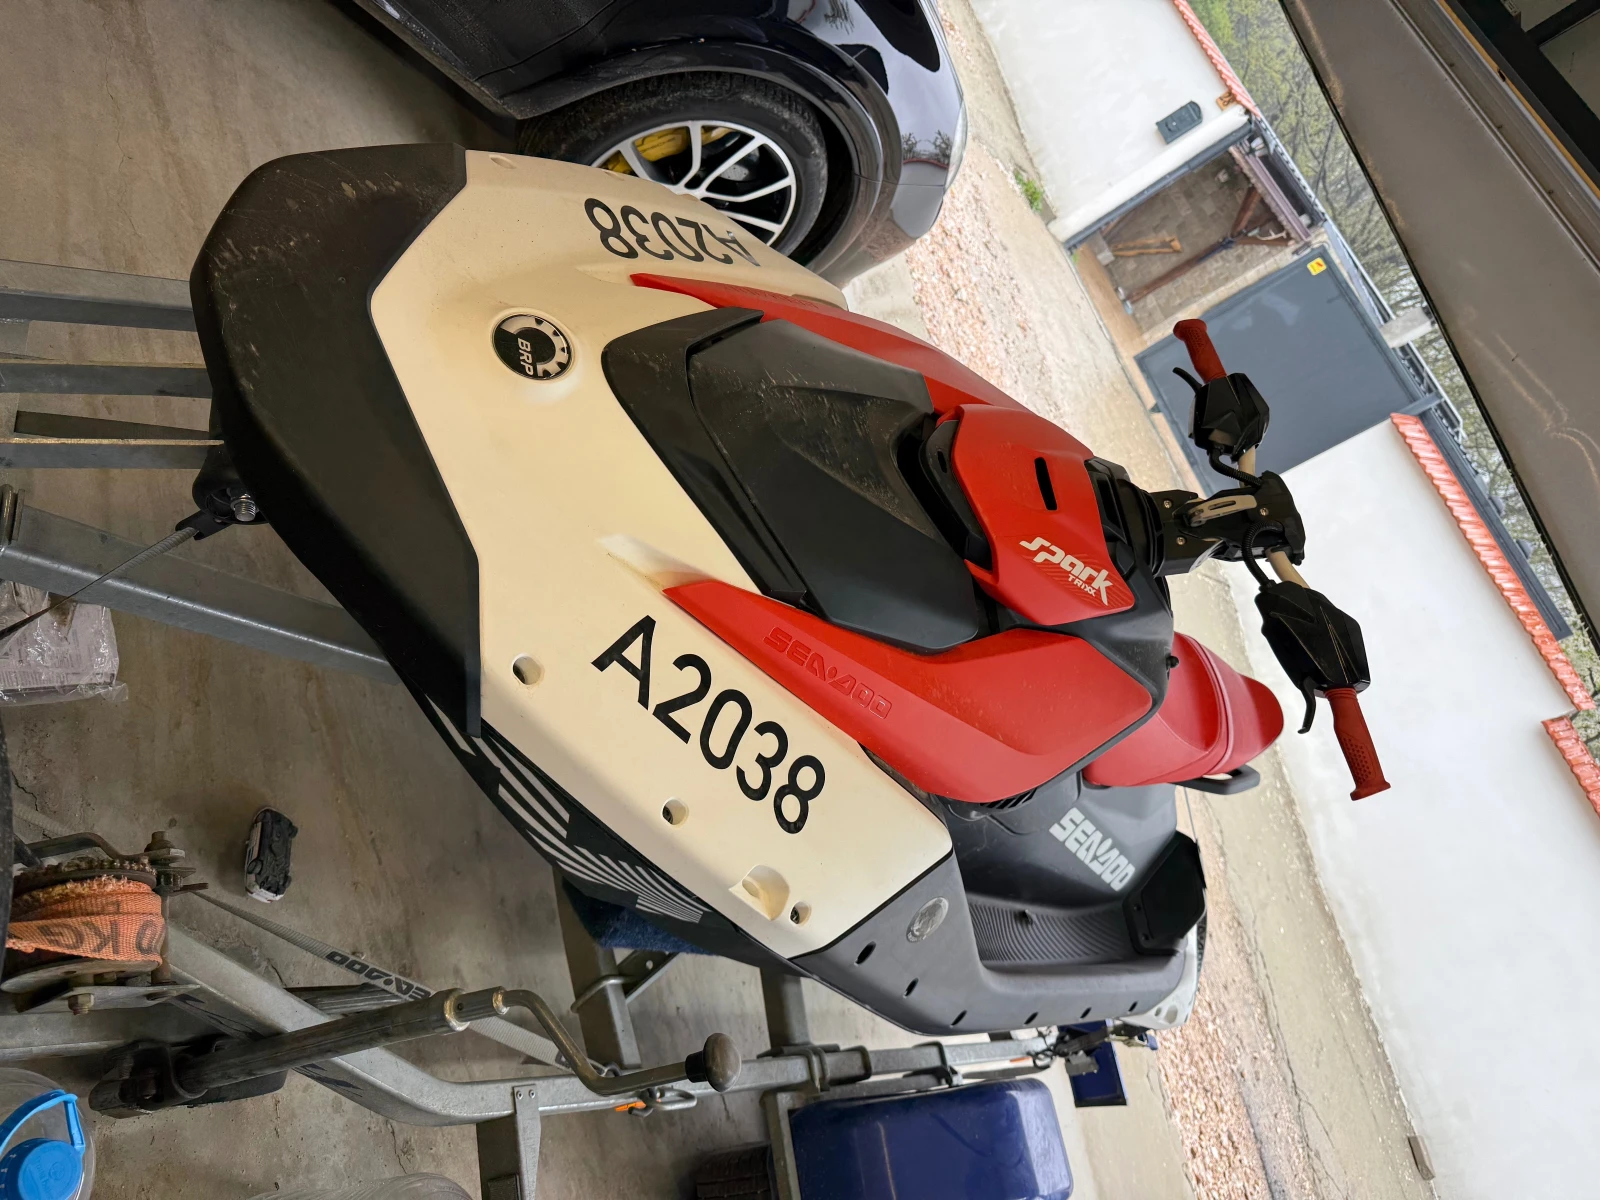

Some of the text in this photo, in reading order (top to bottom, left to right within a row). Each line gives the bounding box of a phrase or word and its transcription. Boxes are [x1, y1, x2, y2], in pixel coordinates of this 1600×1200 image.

[584, 197, 761, 267] A2038
[517, 337, 534, 376] BRP
[1068, 573, 1097, 597] TRIXX
[590, 614, 826, 835] A2038
